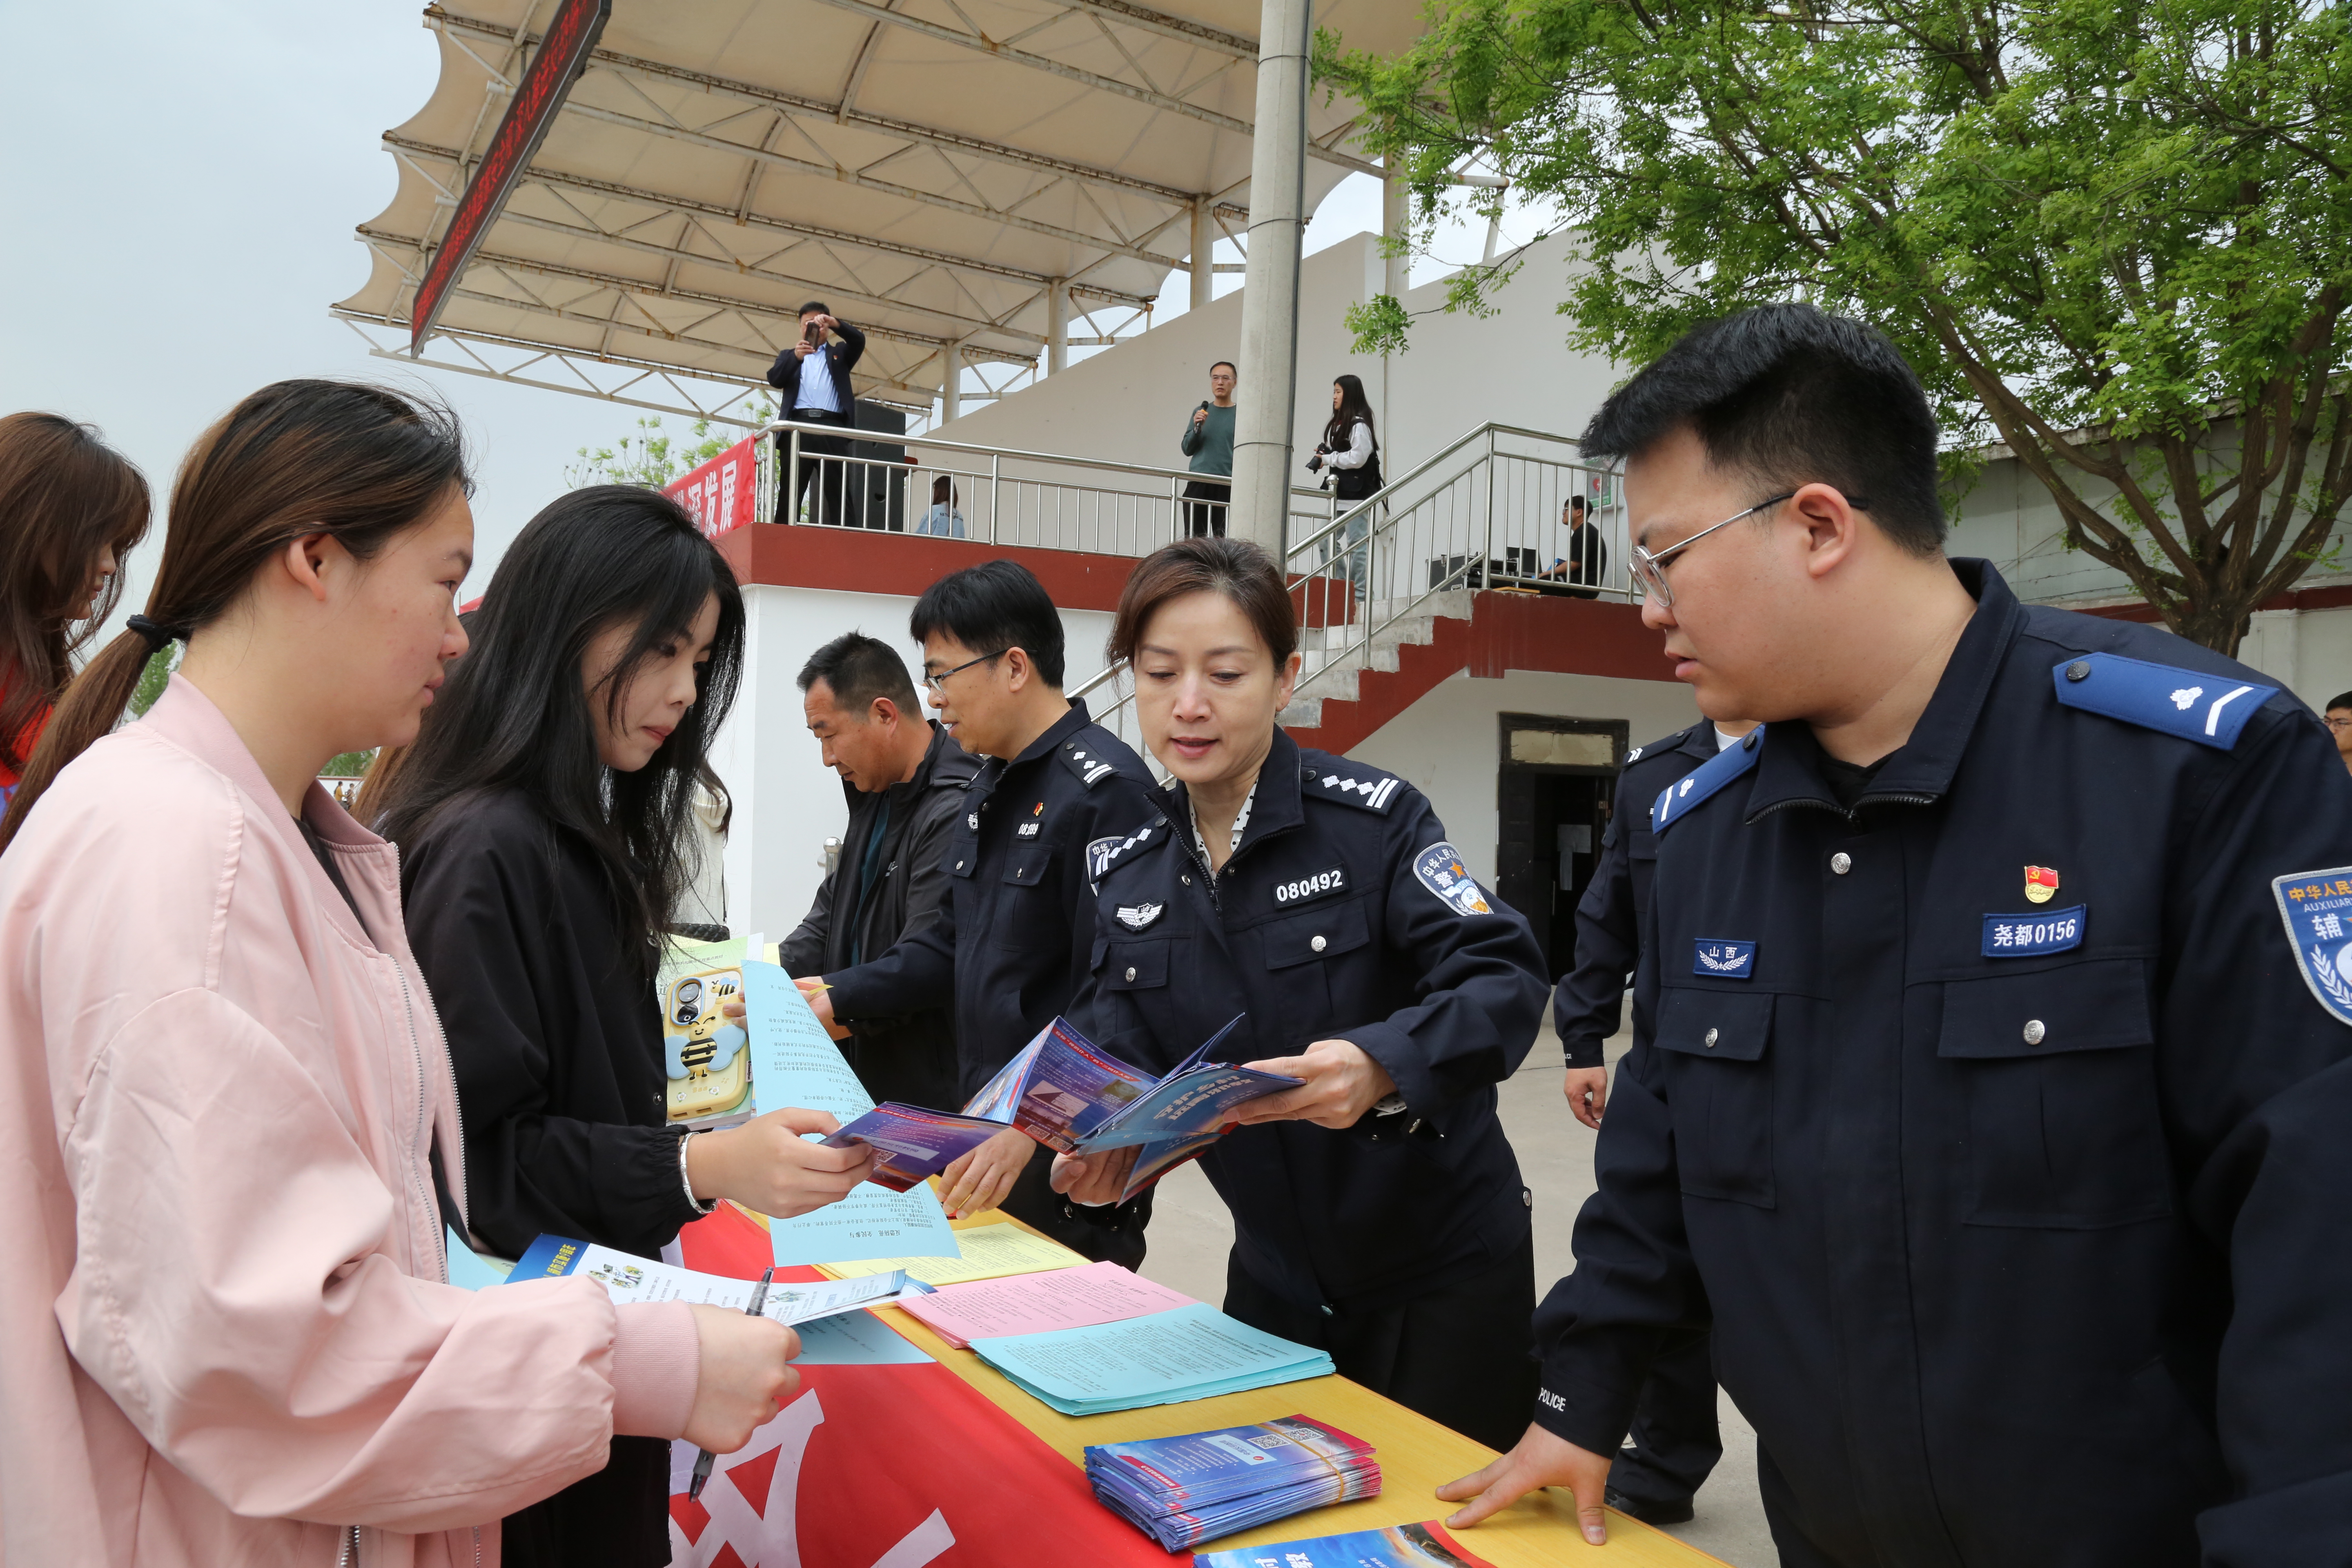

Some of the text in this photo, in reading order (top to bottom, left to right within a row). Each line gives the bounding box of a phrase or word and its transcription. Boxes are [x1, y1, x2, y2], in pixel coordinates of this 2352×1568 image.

[1092, 841, 1113, 856] 中华
[1276, 870, 1343, 903] 080492
[1433, 871, 1454, 888] 警
[2288, 880, 2352, 902] 中华人民
[2303, 897, 2352, 913] AUXILIAR
[1993, 918, 2076, 947] 尧都0156
[2311, 913, 2344, 940] 辅
[1709, 945, 1736, 959] 山西
[849, 1230, 873, 1238] 全民参与
[546, 1244, 577, 1276] 颁布实施9周年
[1538, 1387, 1566, 1412] POLICE
